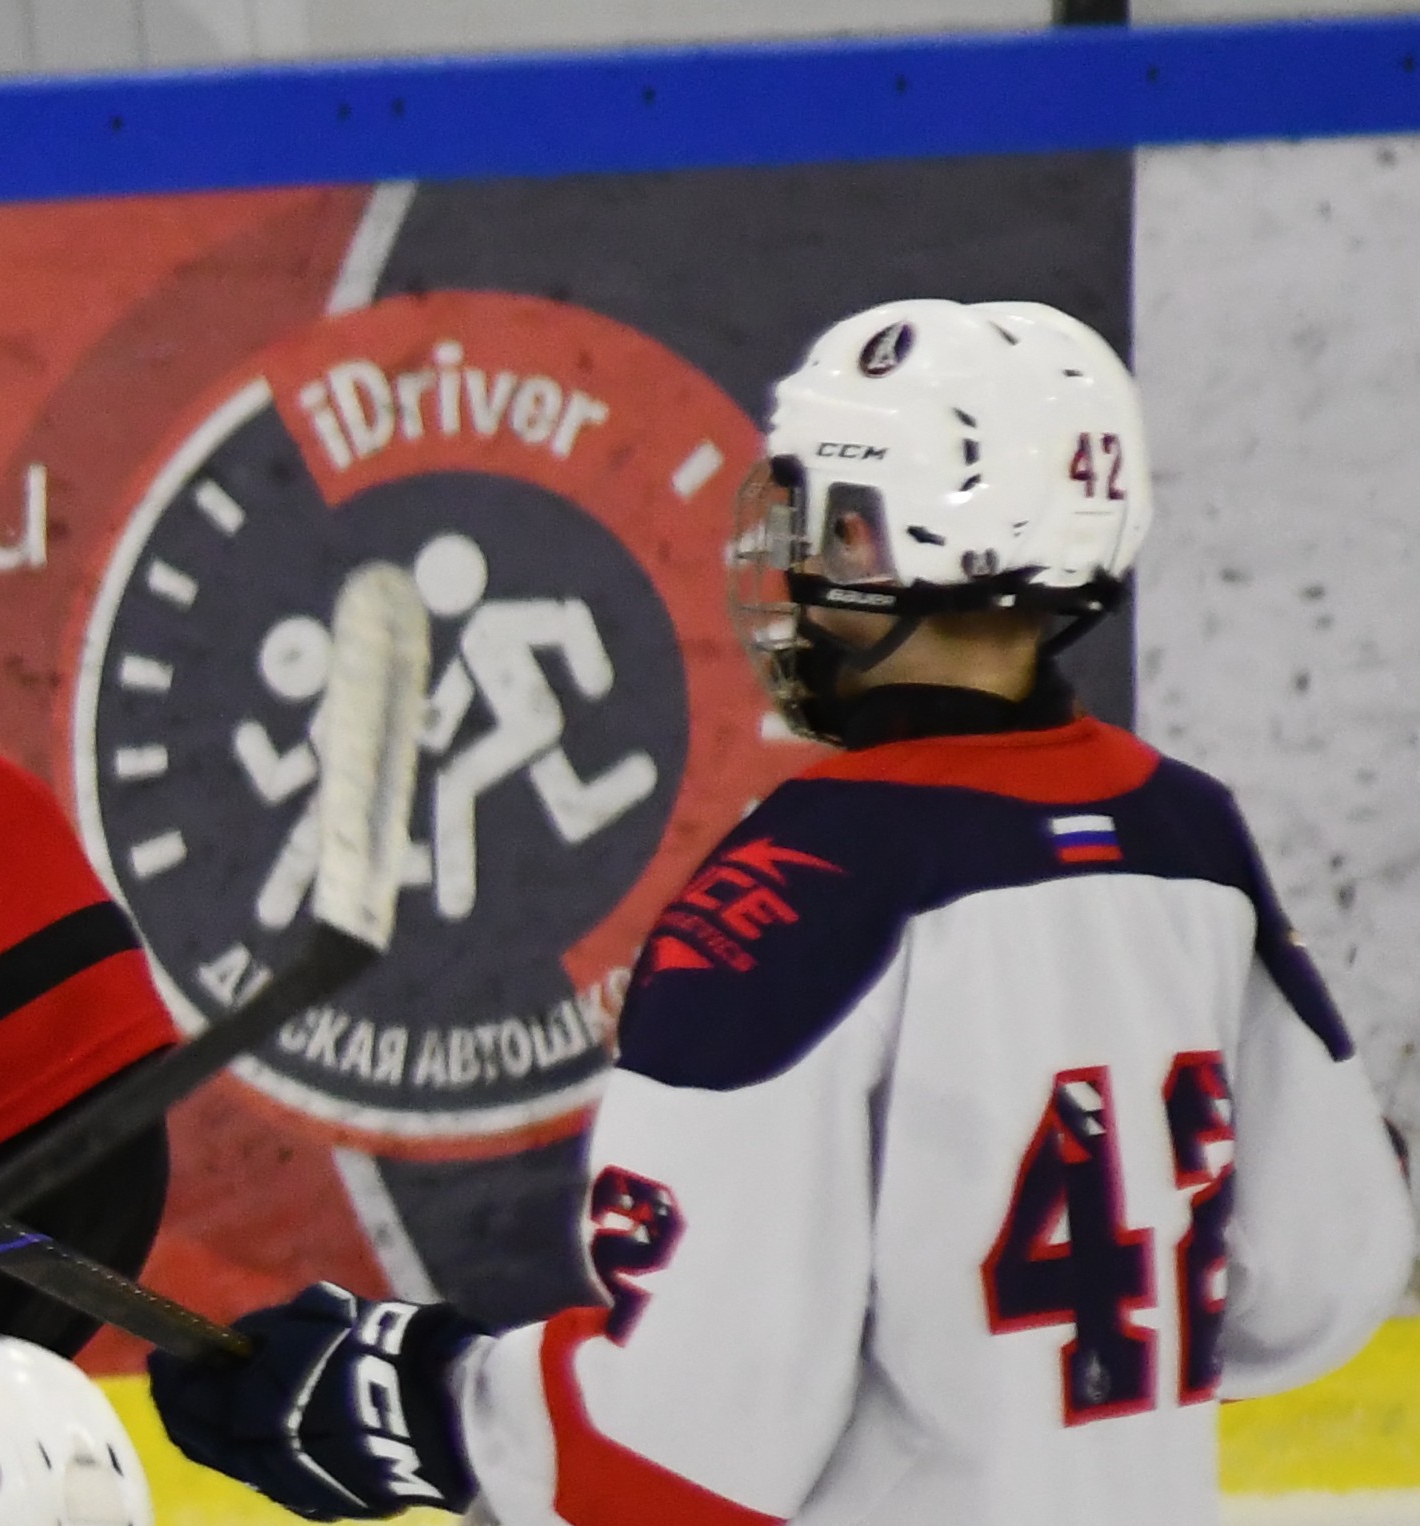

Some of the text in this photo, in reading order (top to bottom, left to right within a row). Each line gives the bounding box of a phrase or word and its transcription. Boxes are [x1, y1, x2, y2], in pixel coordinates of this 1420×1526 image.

[299, 338, 609, 472] iDriver
[816, 442, 890, 461] CCM
[1069, 432, 1125, 500] 42
[679, 866, 801, 942] CE
[413, 960, 639, 1087] АВТОШКО
[979, 1050, 1235, 1428] 42
[357, 1301, 446, 1500] CCM
